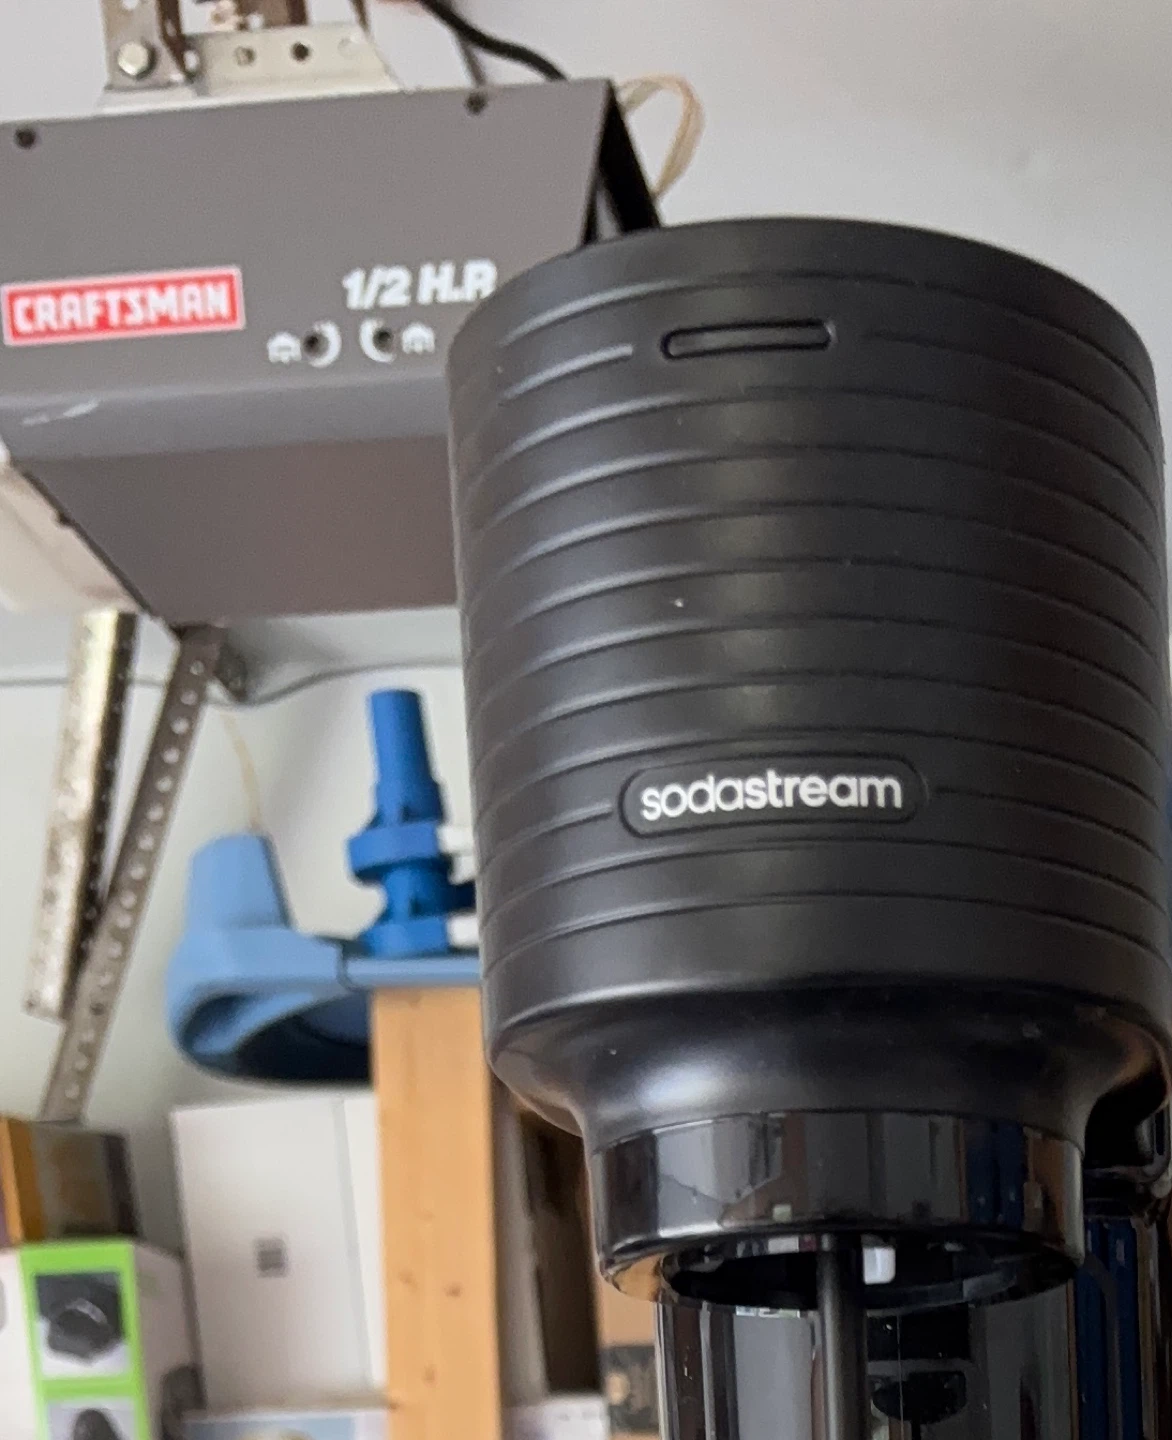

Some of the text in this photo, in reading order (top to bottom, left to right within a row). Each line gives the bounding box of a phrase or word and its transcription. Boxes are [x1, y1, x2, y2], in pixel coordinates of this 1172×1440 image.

[13, 281, 230, 333] CRAFTSMAN
[341, 265, 412, 310] 1/2
[639, 768, 903, 822] sodastream
